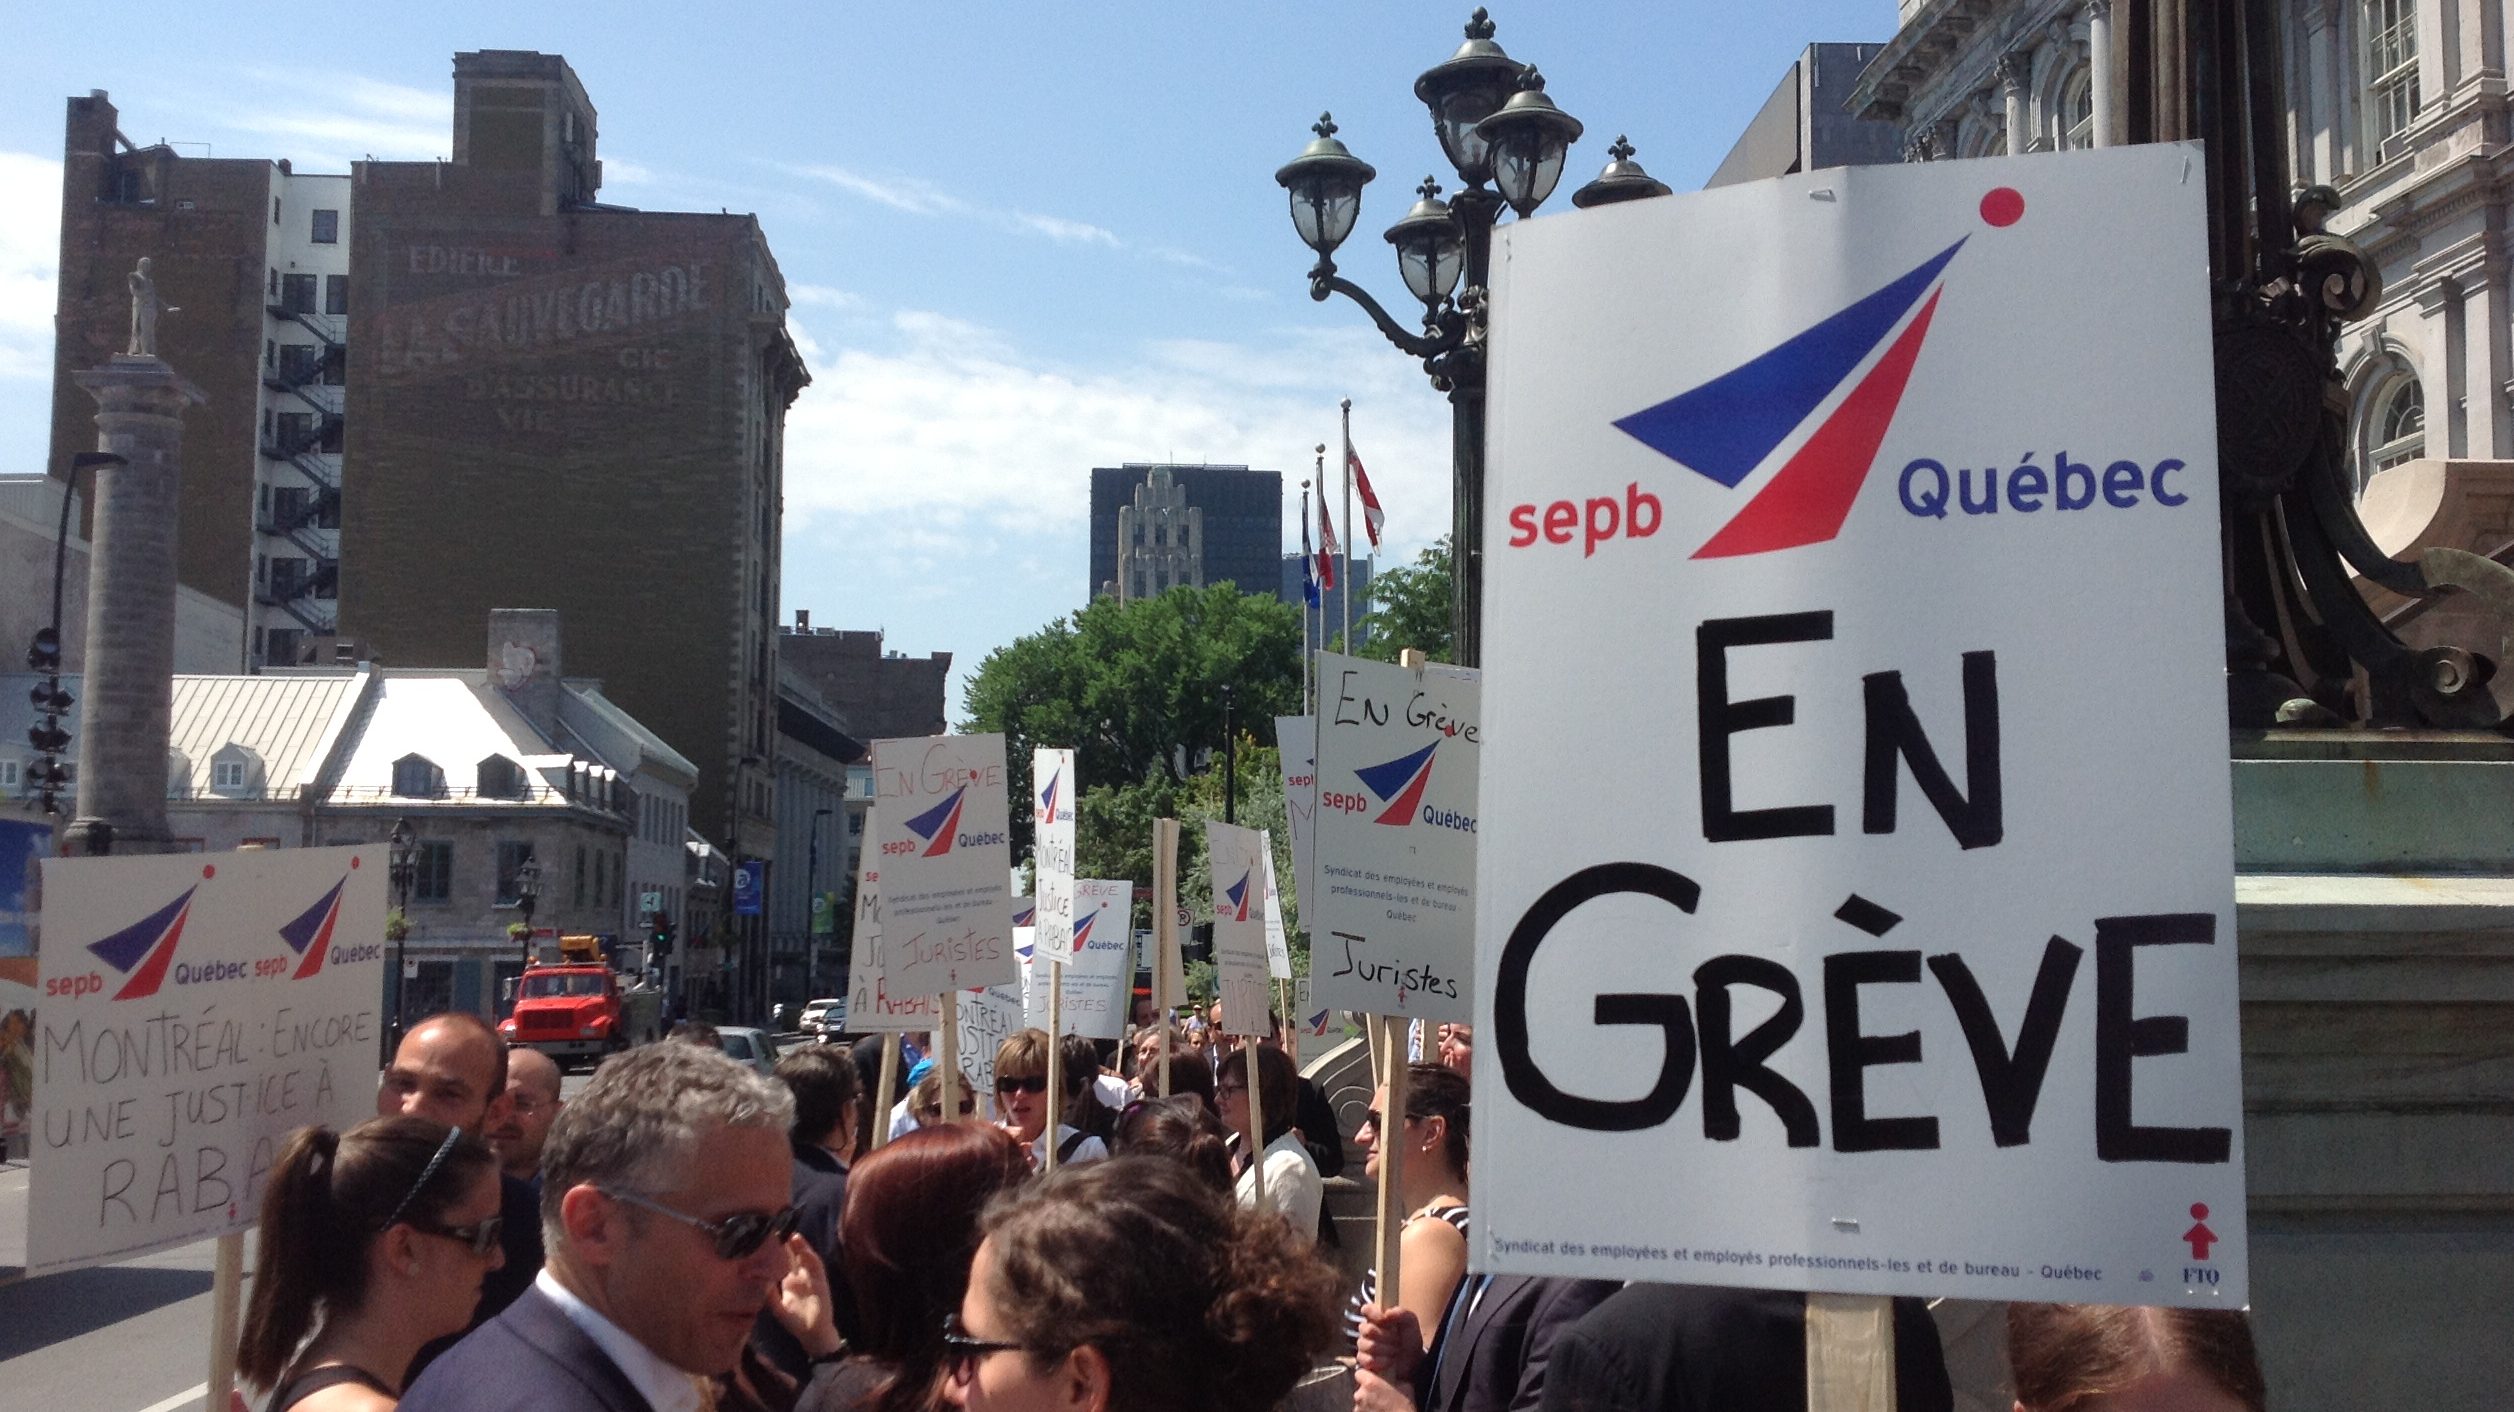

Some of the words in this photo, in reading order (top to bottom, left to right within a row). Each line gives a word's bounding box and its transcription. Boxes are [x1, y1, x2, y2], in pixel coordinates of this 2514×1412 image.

[1508, 482, 1662, 559] sepb
[1899, 450, 2190, 519] Québec
[1696, 609, 2003, 850] EN
[1288, 773, 1314, 789] sep
[1323, 790, 1367, 815] sepb
[1423, 803, 1478, 834] Québec
[882, 839, 916, 856] sepb
[45, 971, 104, 1000] sepb
[174, 959, 249, 986] Québec
[254, 953, 289, 981] sepb
[331, 942, 381, 966] Québec
[1331, 931, 1458, 999] Juristes
[272, 1007, 372, 1059] ENCORE
[1494, 861, 2231, 1164] GRÈVE
[45, 1098, 138, 1149] UNE
[1495, 1239, 1555, 1257] Syndicat
[1560, 1242, 1585, 1256] des
[1591, 1243, 1668, 1261] employées
[1674, 1247, 1688, 1261] et
[1694, 1248, 1763, 1266] employés
[1917, 1259, 1934, 1274] et
[1939, 1259, 1958, 1275] de
[1965, 1260, 2021, 1278] bureau
[2040, 1263, 2102, 1282] Québec
